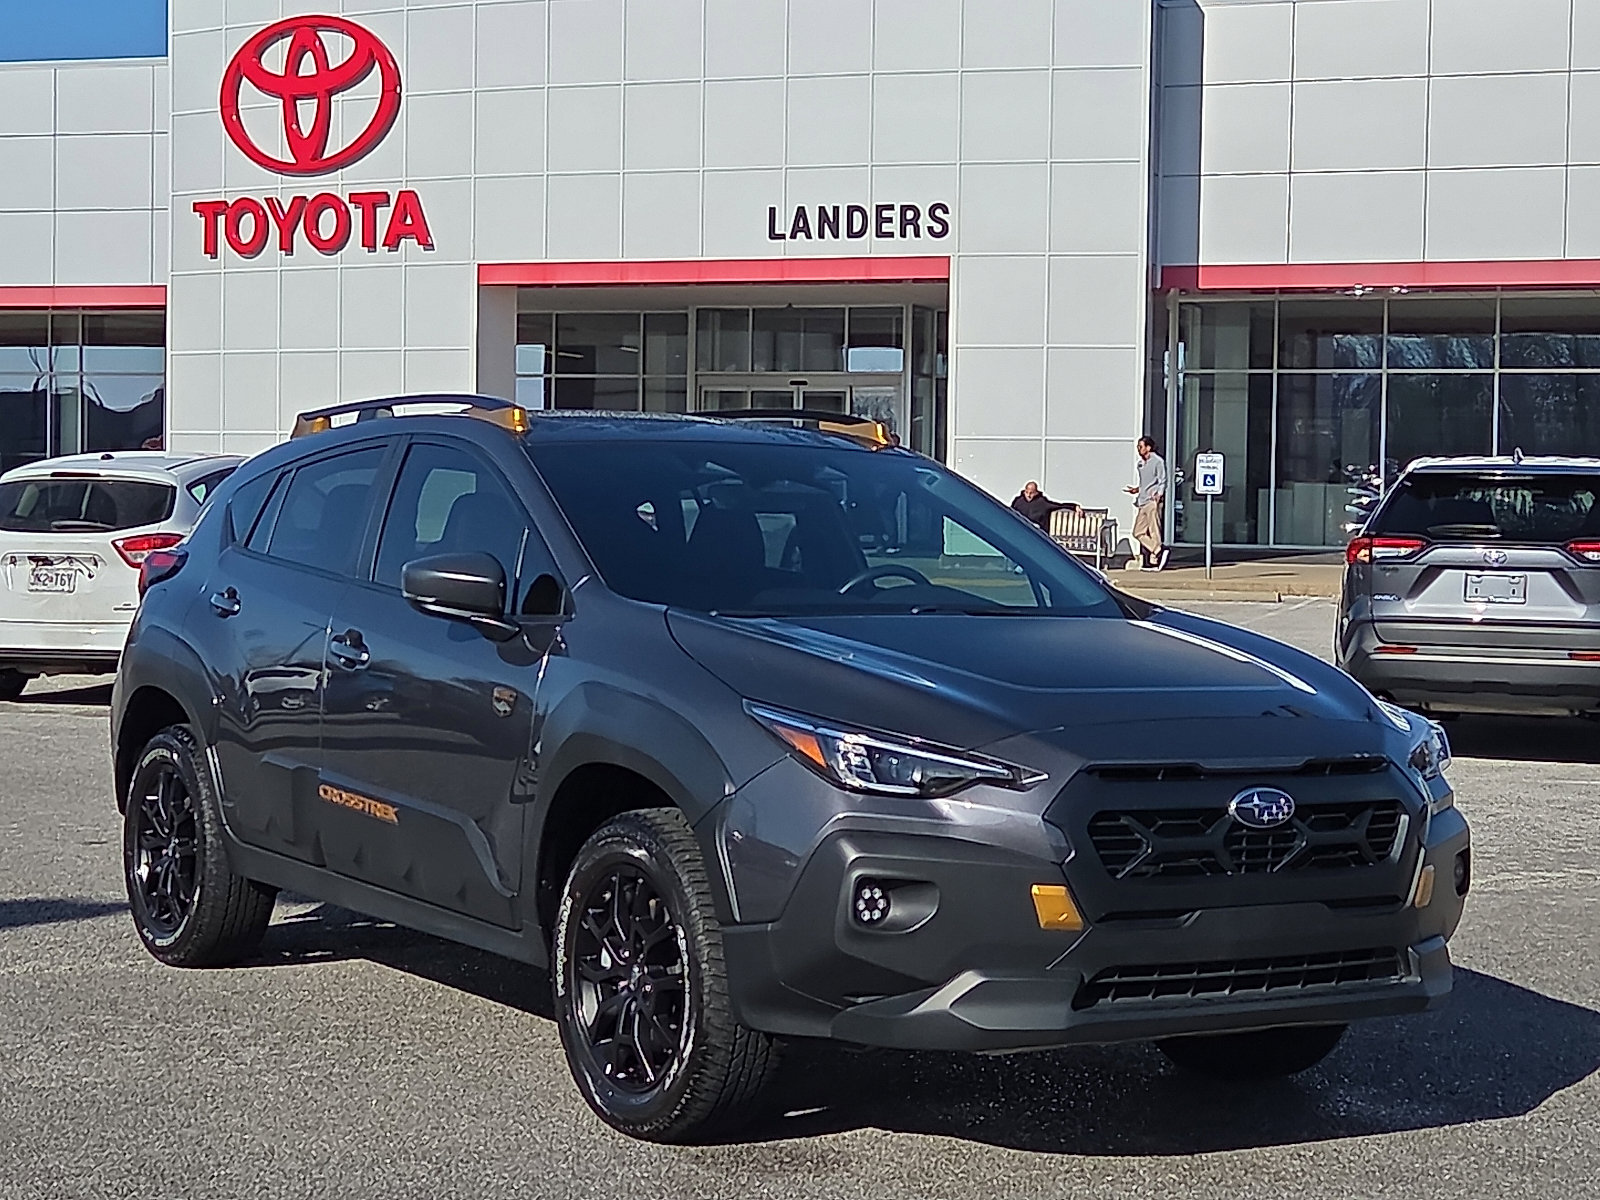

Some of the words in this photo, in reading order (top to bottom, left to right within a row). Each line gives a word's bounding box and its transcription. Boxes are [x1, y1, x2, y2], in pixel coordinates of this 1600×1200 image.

[193, 189, 435, 258] TOYOTA
[768, 202, 951, 241] LANDERS
[318, 784, 400, 825] CROSSTREK
